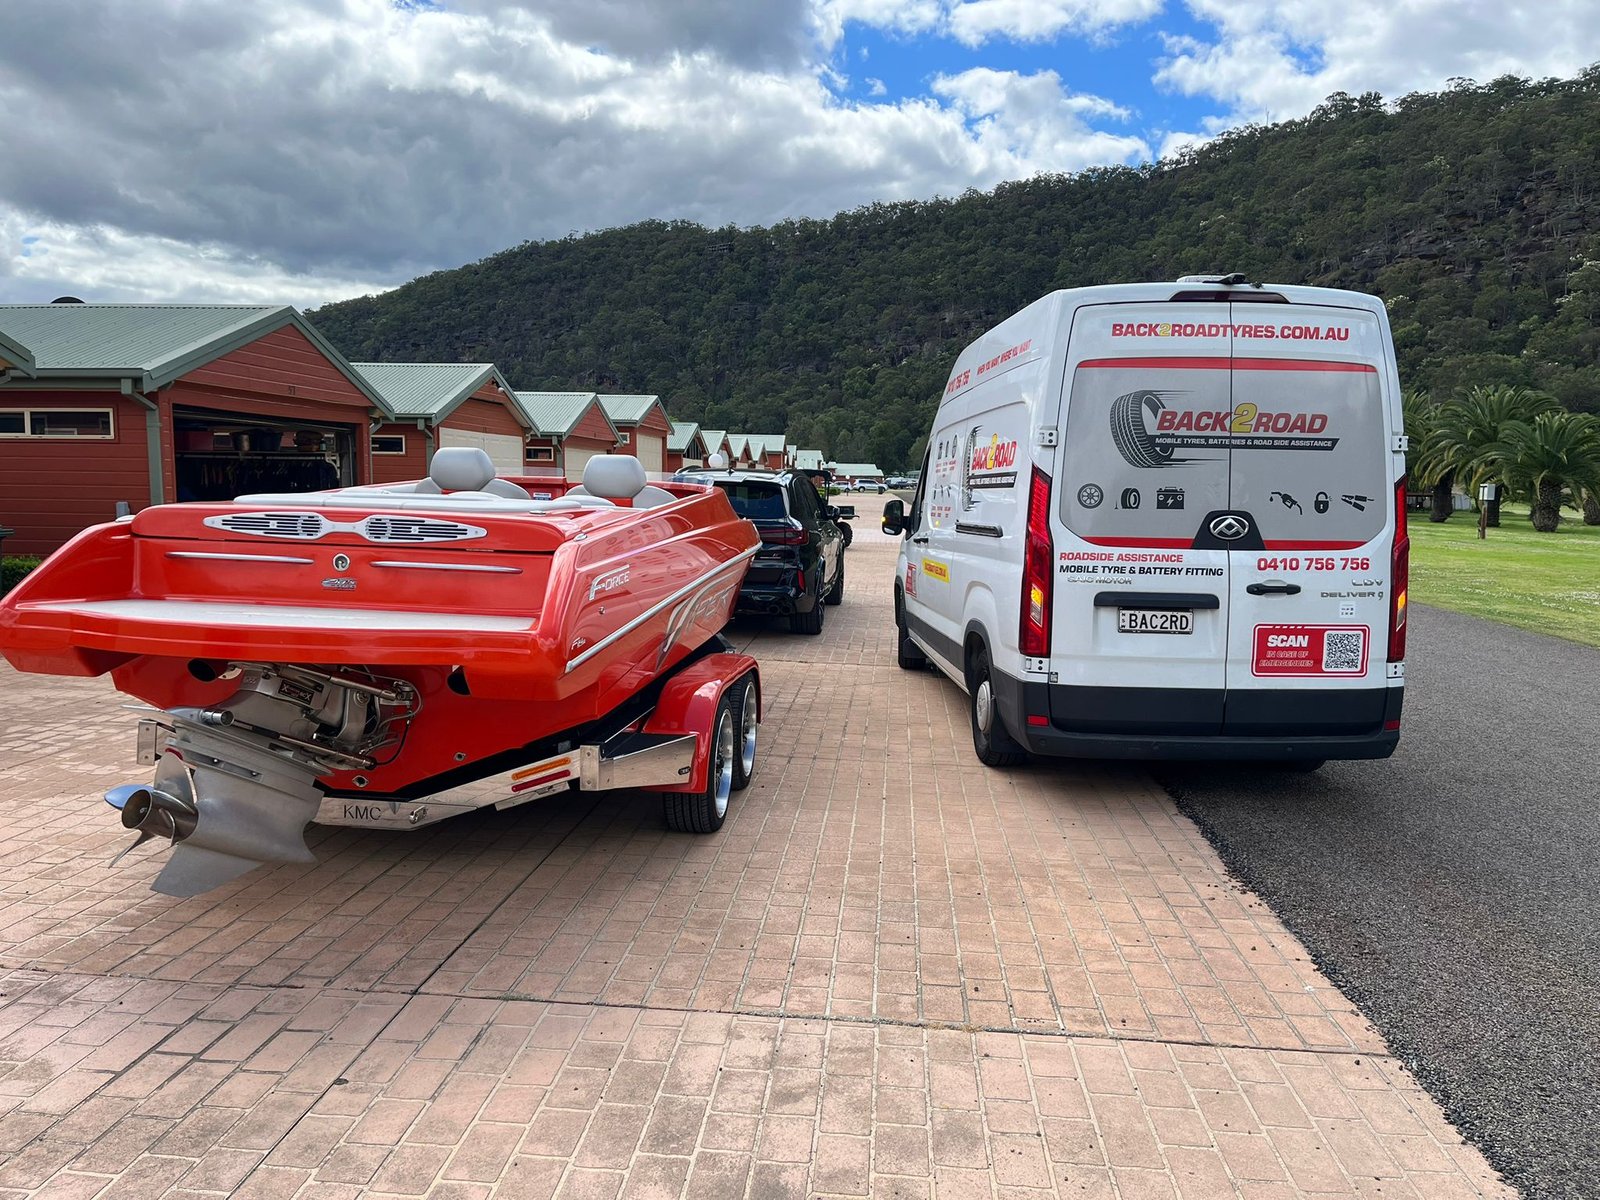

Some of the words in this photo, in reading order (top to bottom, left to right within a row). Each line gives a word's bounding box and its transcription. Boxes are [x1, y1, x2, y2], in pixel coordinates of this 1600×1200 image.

[1112, 323, 1350, 341] BACK2ROADTYRES.COM.AU
[1156, 402, 1328, 434] BACK2ROAD
[1183, 438, 1207, 446] TYRES,
[1208, 438, 1246, 446] BATTERIES
[971, 432, 1017, 470] BACK2ROAD
[1059, 552, 1114, 561] ROADSIDE
[1116, 553, 1183, 563] ASSISTANCE
[1257, 557, 1300, 571] 0410
[1303, 557, 1335, 571] 756
[1339, 557, 1370, 571] 756
[1059, 565, 1098, 574] MOBILE
[1101, 566, 1126, 574] TYRE
[1138, 567, 1183, 576] BATTERY
[1184, 568, 1224, 577] FITTING
[1067, 575, 1094, 583] SAIC
[1095, 576, 1132, 585] MOTOR
[1128, 613, 1189, 630] BAC2RD
[1267, 635, 1309, 648] SCAN
[343, 805, 381, 820] KMC
